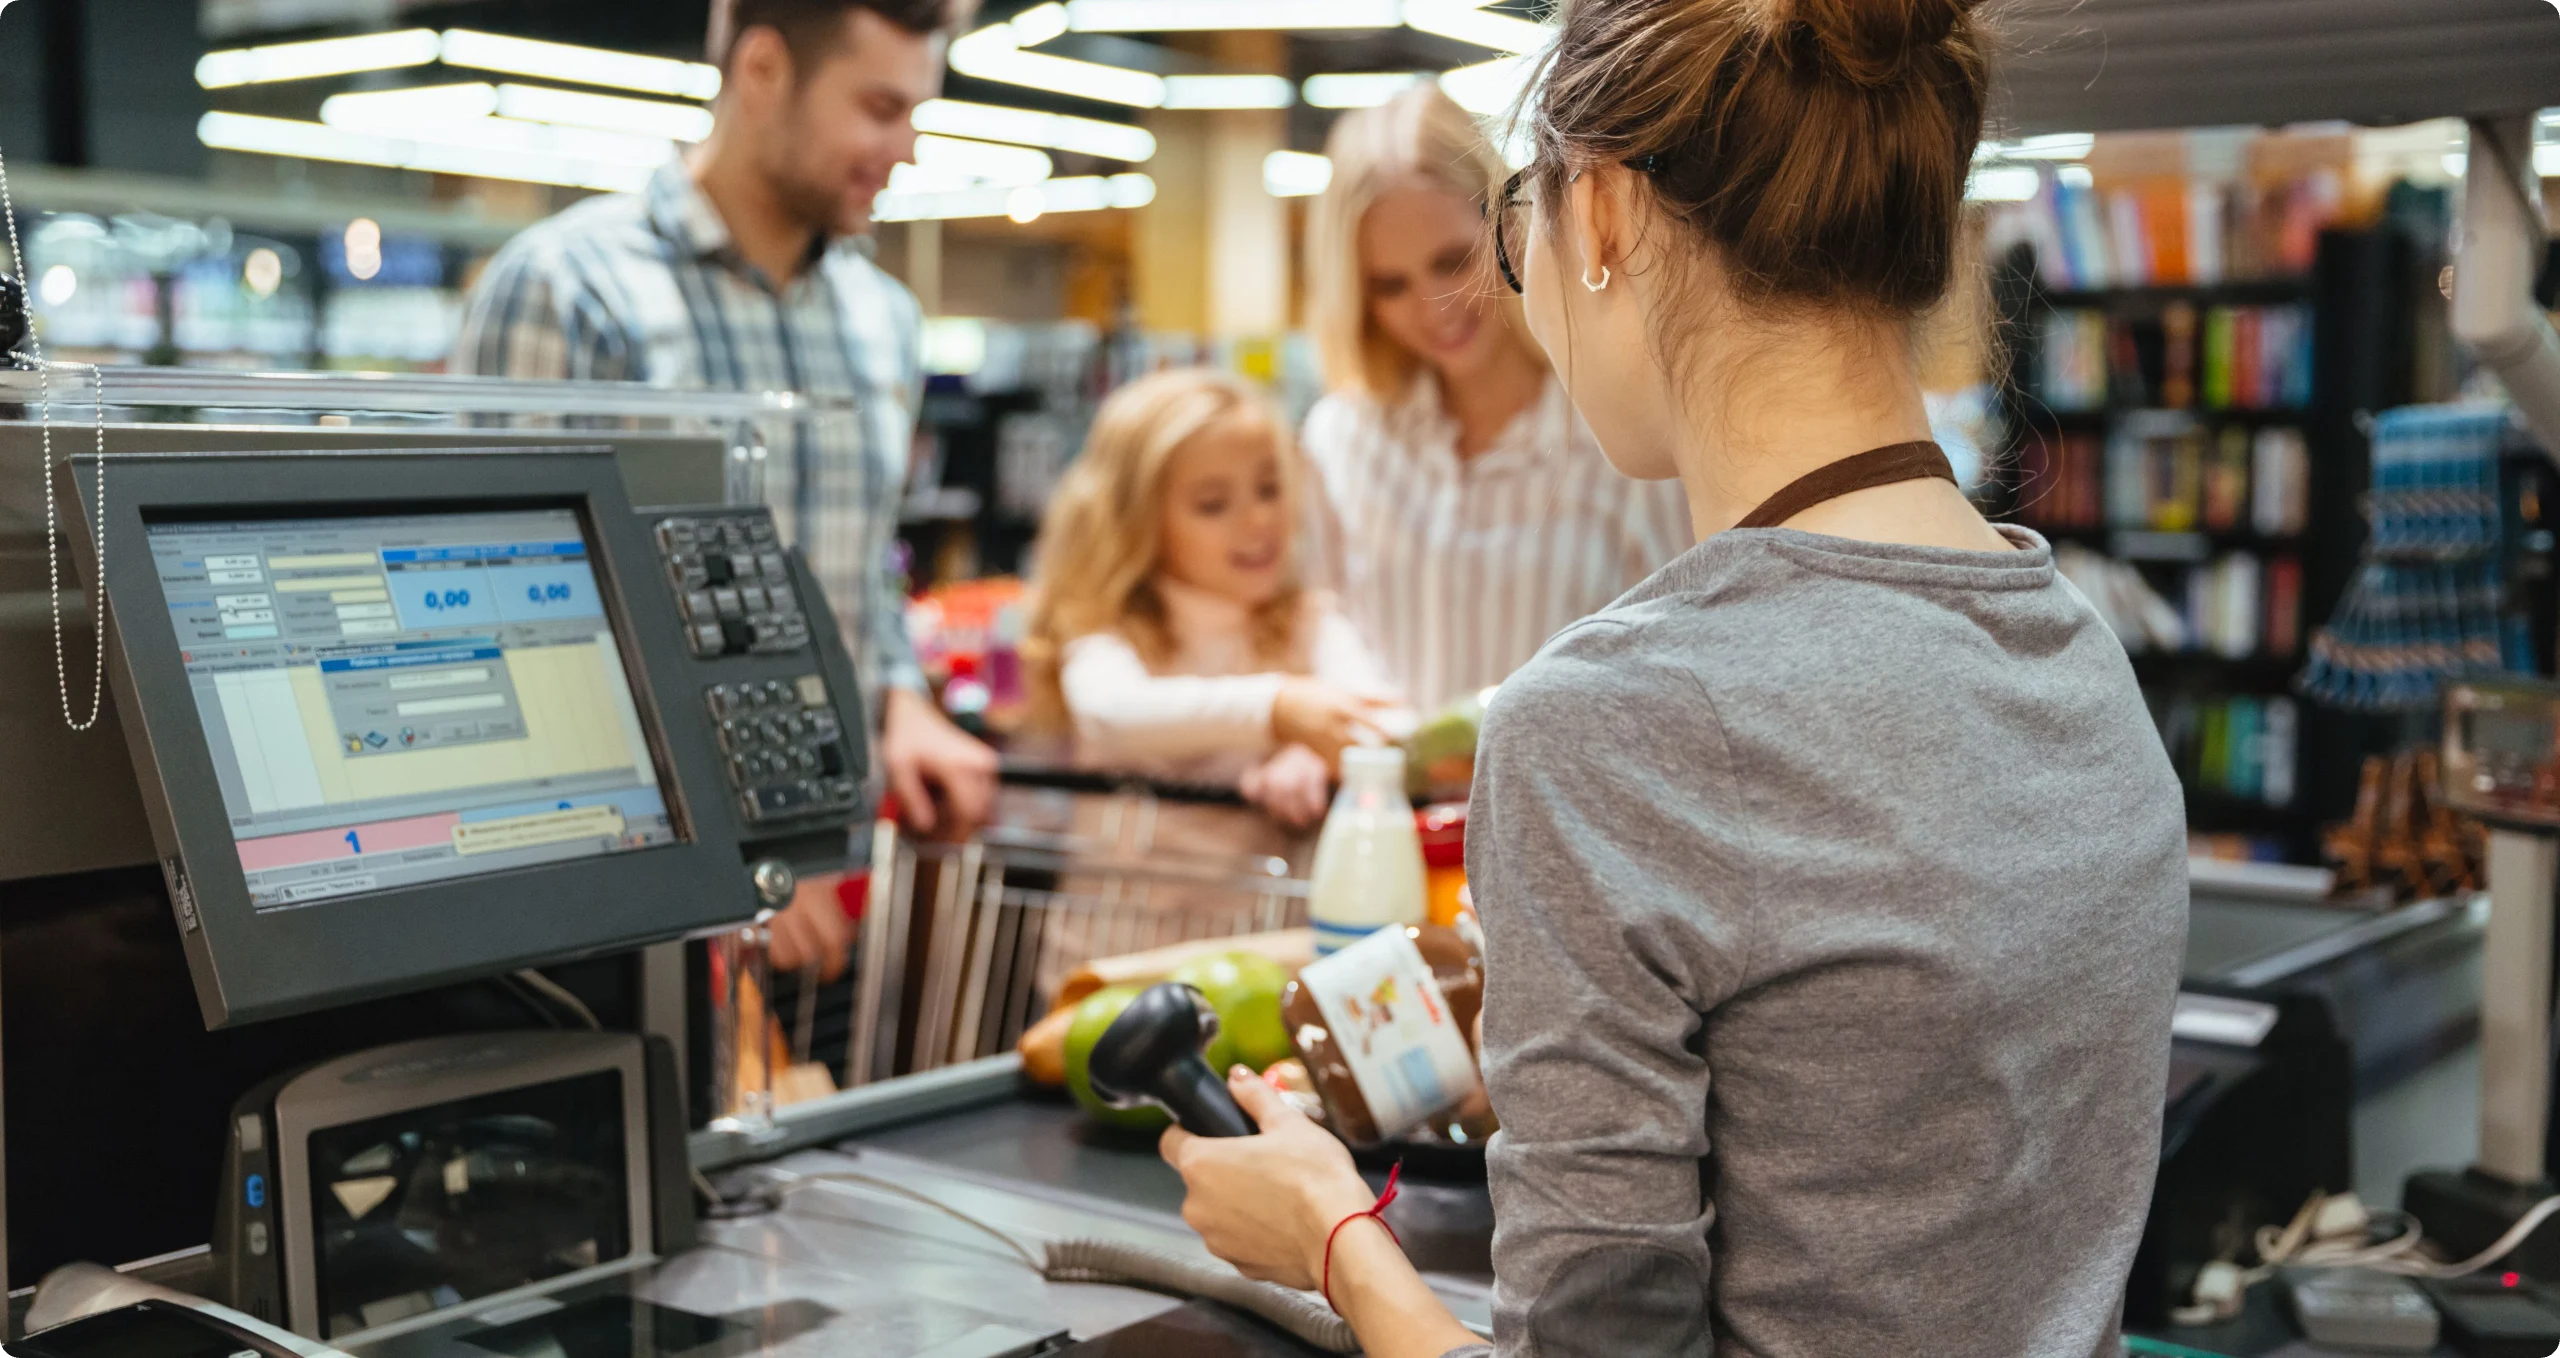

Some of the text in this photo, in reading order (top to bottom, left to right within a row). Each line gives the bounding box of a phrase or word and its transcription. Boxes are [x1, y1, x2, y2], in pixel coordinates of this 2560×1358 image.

[424, 588, 471, 611] 0,00
[528, 581, 571, 605] 0,00
[345, 830, 361, 853] 1
